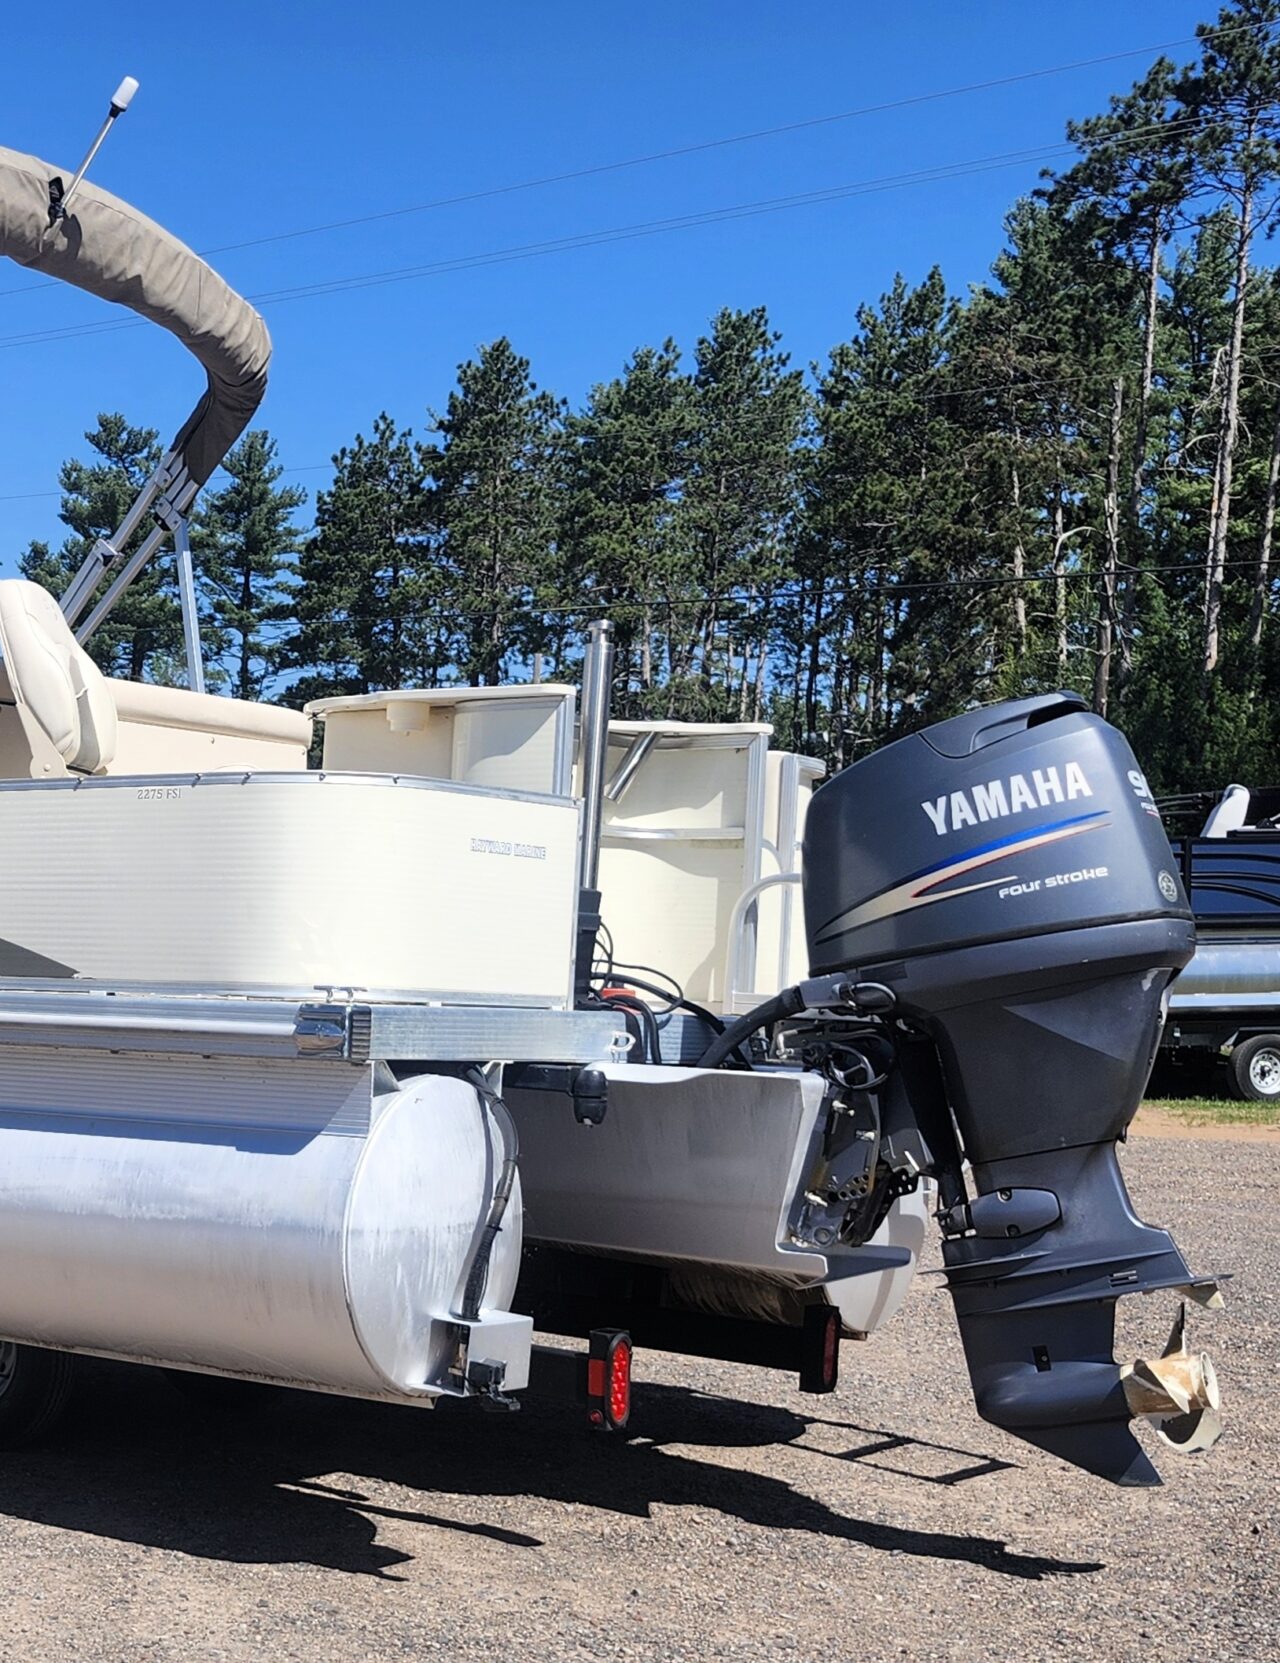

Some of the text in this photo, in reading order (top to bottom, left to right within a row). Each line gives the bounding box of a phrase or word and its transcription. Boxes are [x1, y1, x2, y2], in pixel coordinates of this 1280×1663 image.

[137, 788, 181, 800] 2275 FSI
[920, 761, 1094, 836] YAMAHA
[513, 843, 546, 860] MARINE
